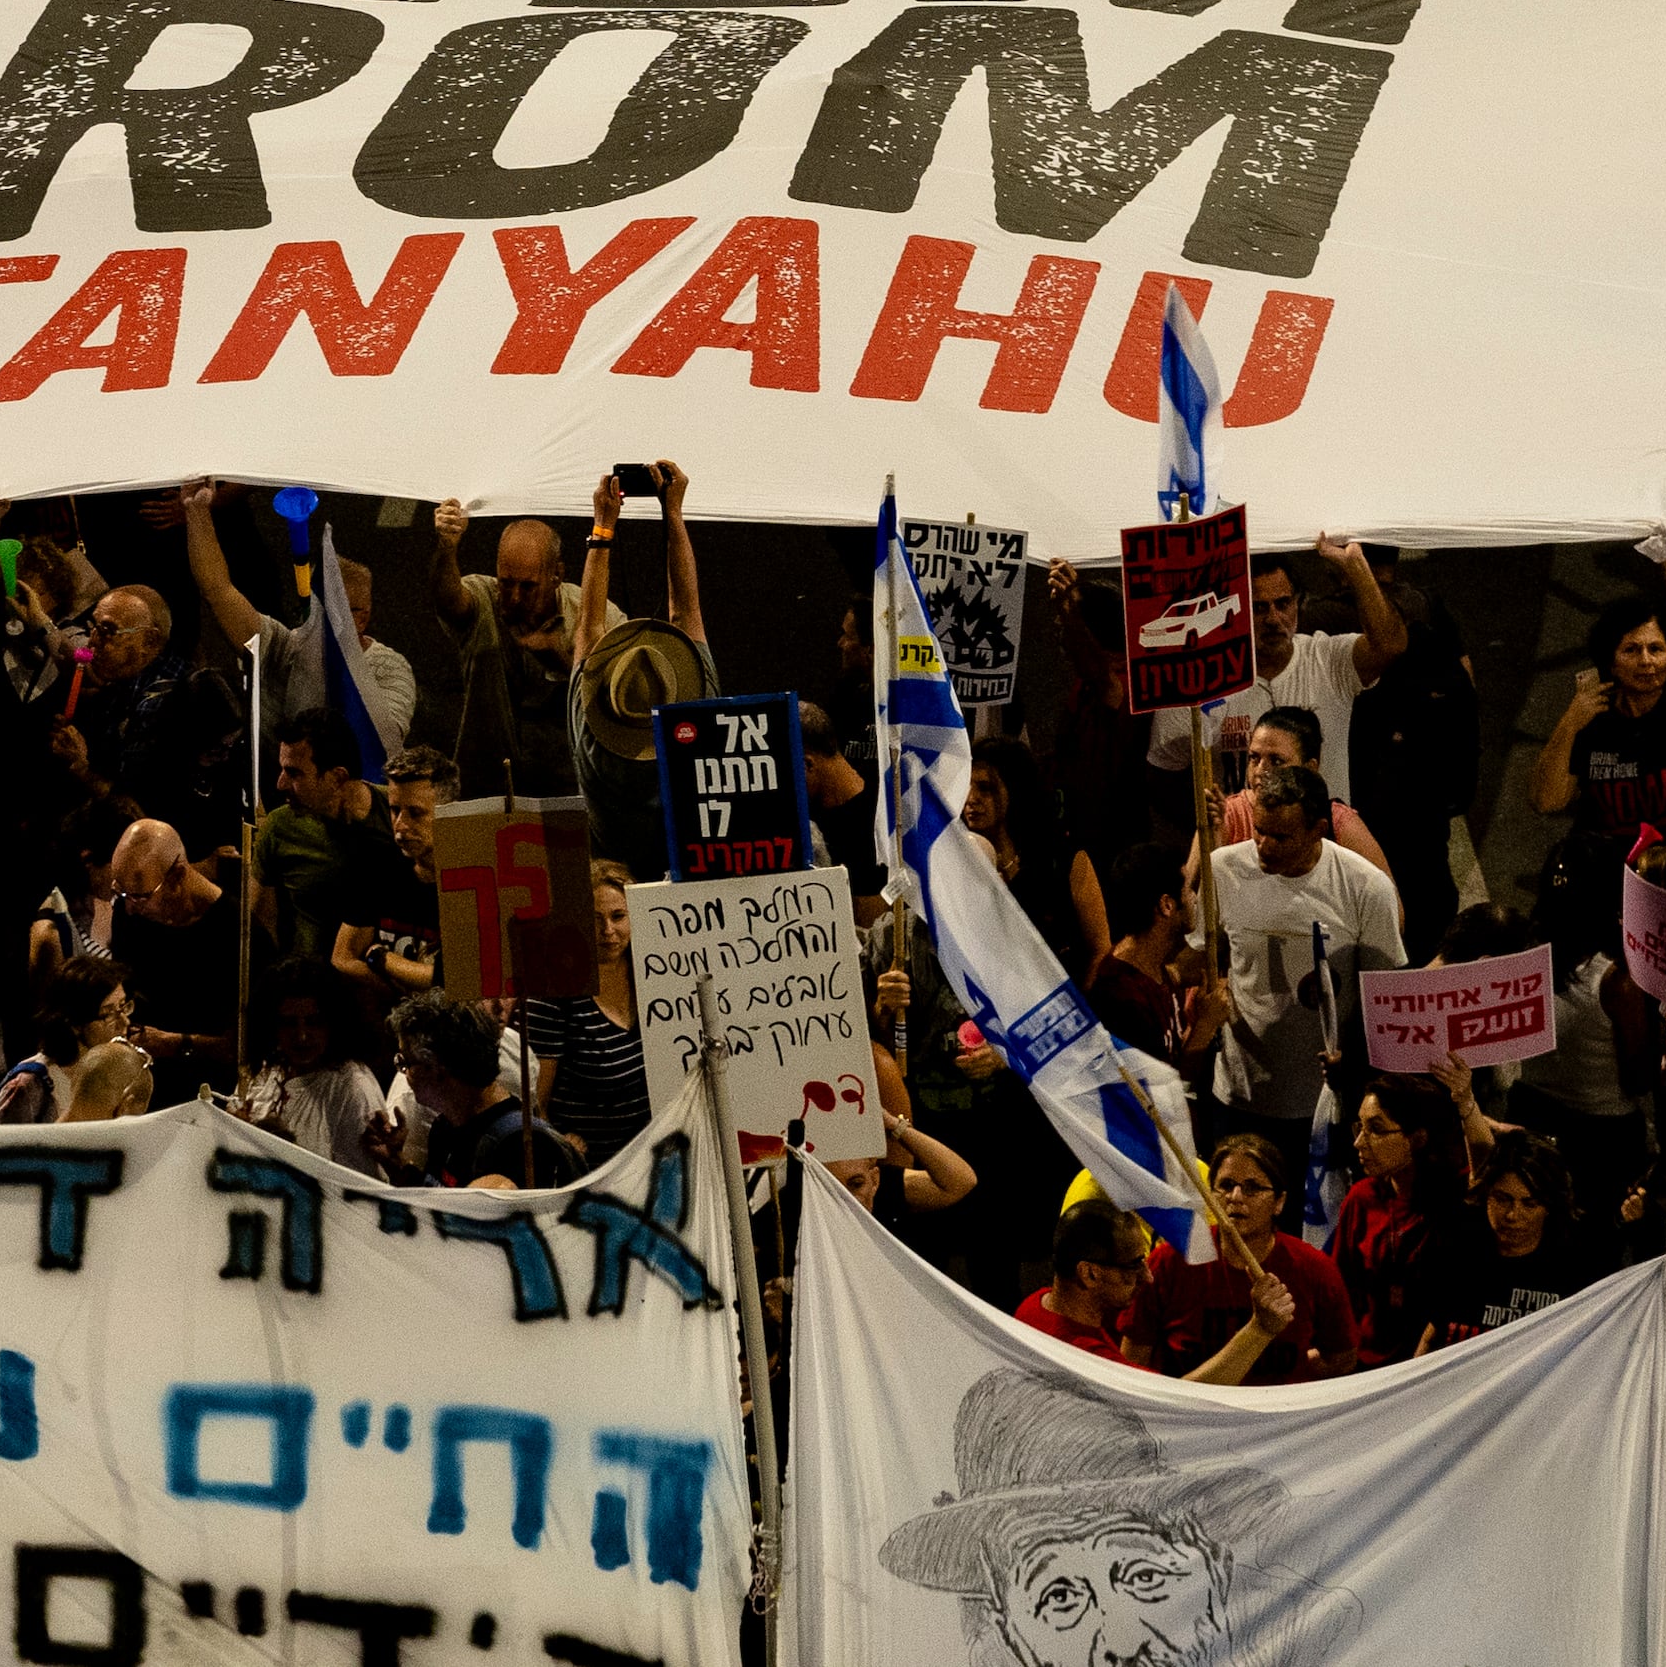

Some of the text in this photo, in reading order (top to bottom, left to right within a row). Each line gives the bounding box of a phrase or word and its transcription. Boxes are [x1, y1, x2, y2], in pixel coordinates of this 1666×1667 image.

[903, 522, 1024, 560] מי שהרס
[1124, 514, 1245, 564] בחירות
[966, 558, 1018, 589] לא
[1134, 645, 1248, 701] עכשיו!
[715, 712, 769, 754] אל
[693, 754, 780, 796] תתנו
[697, 800, 732, 839] לו
[686, 836, 794, 877] להקריב
[648, 896, 726, 939] מפה
[645, 987, 731, 1028] עמם
[1490, 973, 1545, 1002] קול
[1462, 1004, 1538, 1044] זועק
[209, 1132, 723, 1320] אריה
[163, 1281, 714, 1589] החיים
